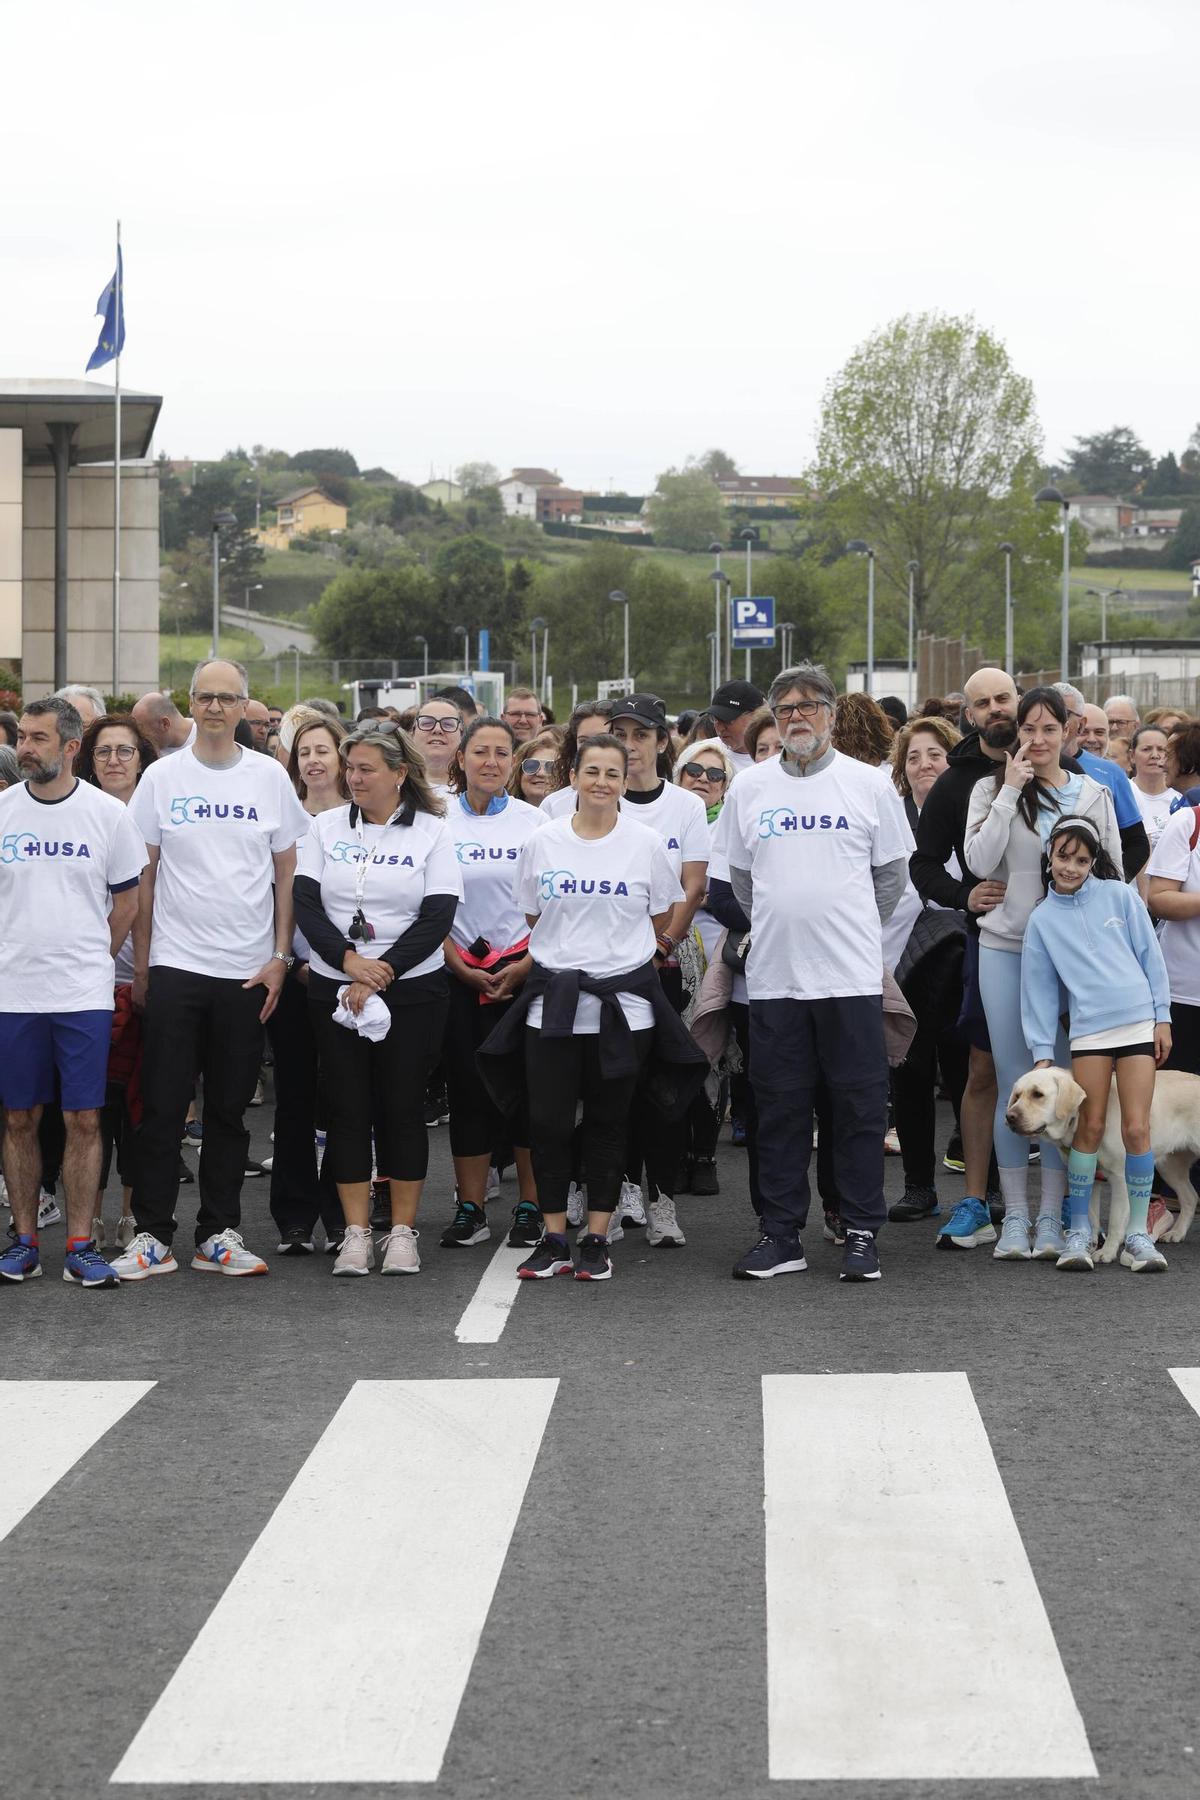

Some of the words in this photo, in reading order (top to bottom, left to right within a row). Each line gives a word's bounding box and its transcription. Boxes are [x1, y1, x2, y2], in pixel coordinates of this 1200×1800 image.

[737, 601, 757, 624] P
[469, 847, 524, 860] HUS
[1127, 1175, 1153, 1185] YOU
[1130, 1189, 1152, 1198] PAC
